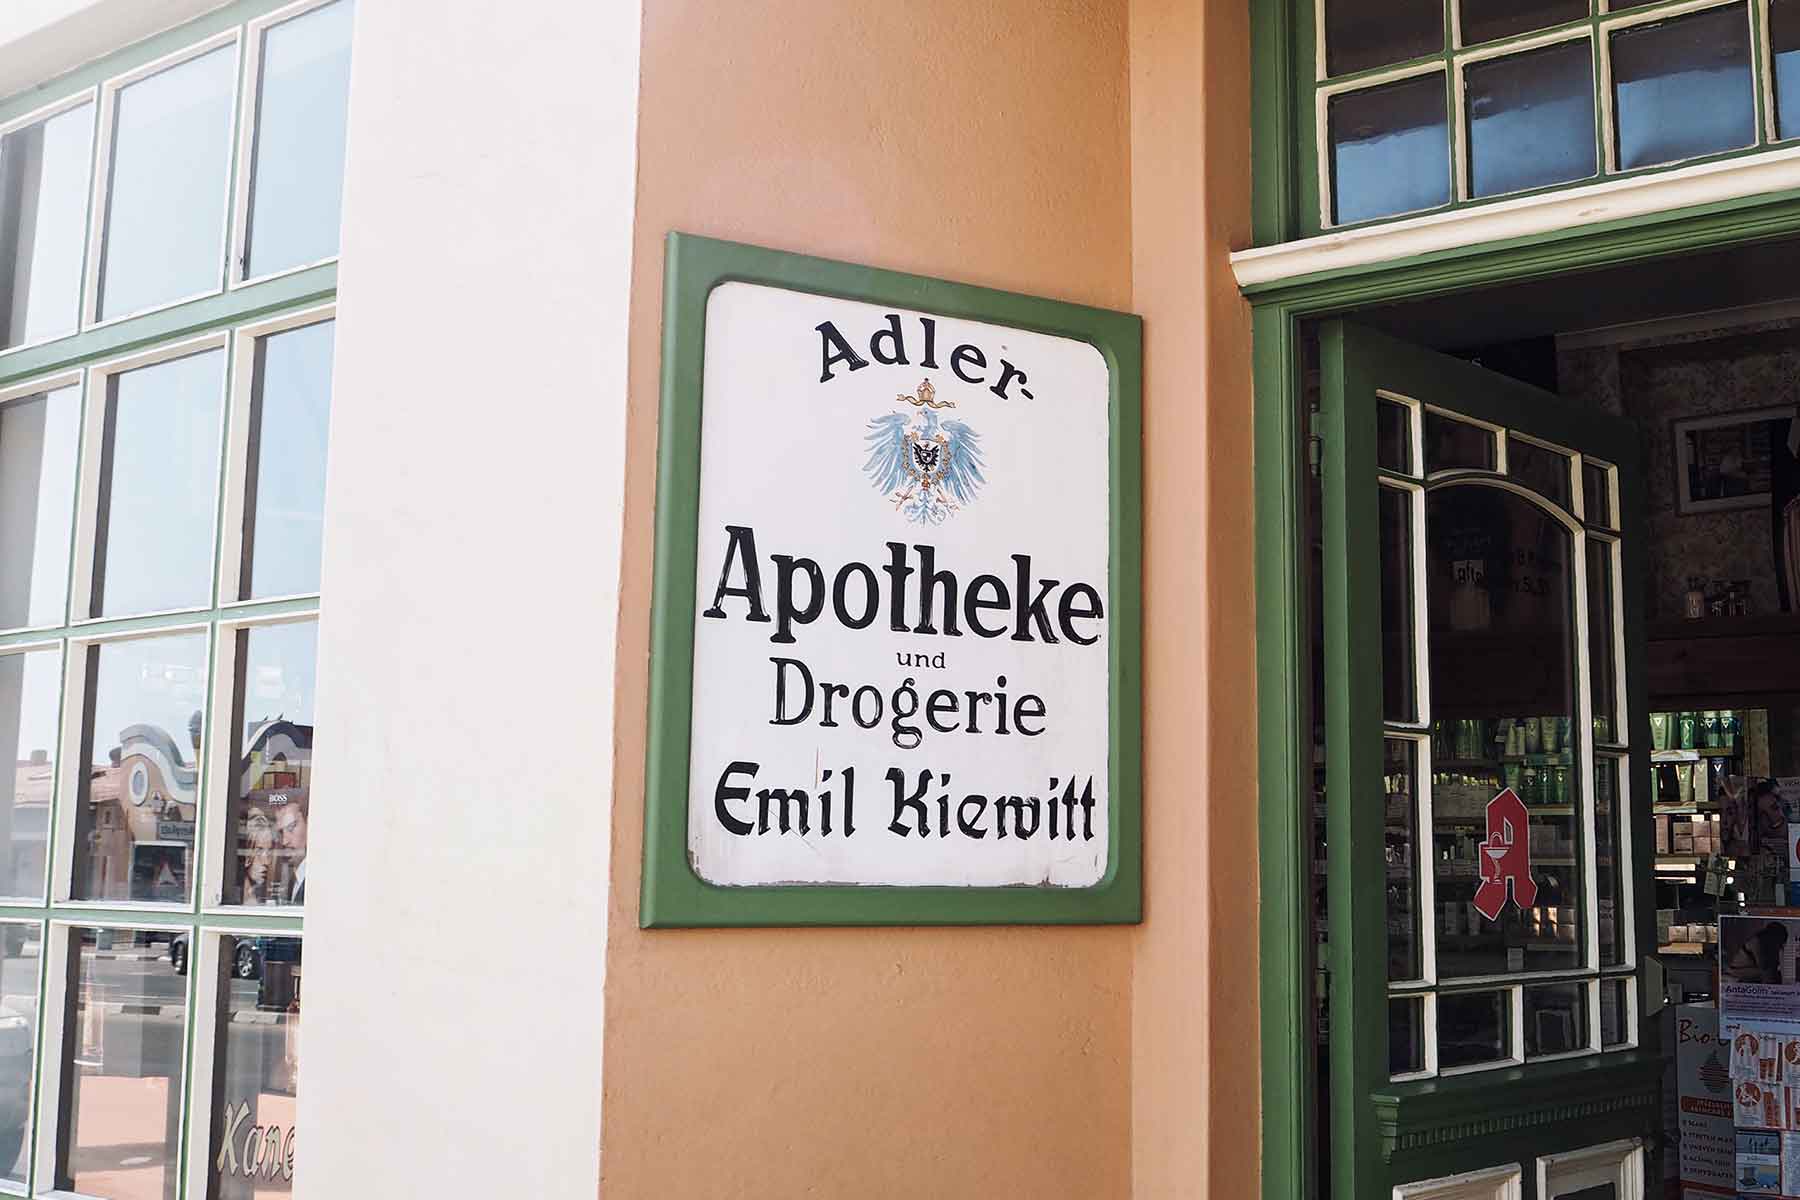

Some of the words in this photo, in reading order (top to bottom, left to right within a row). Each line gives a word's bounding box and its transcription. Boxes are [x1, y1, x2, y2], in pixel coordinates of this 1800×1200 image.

[703, 526, 1104, 646] Apotheke
[896, 652, 946, 669] und
[768, 657, 1047, 750] Drogerie
[268, 793, 288, 803] BOSS
[714, 761, 856, 838] Emil
[885, 767, 1096, 841] Kiewitt
